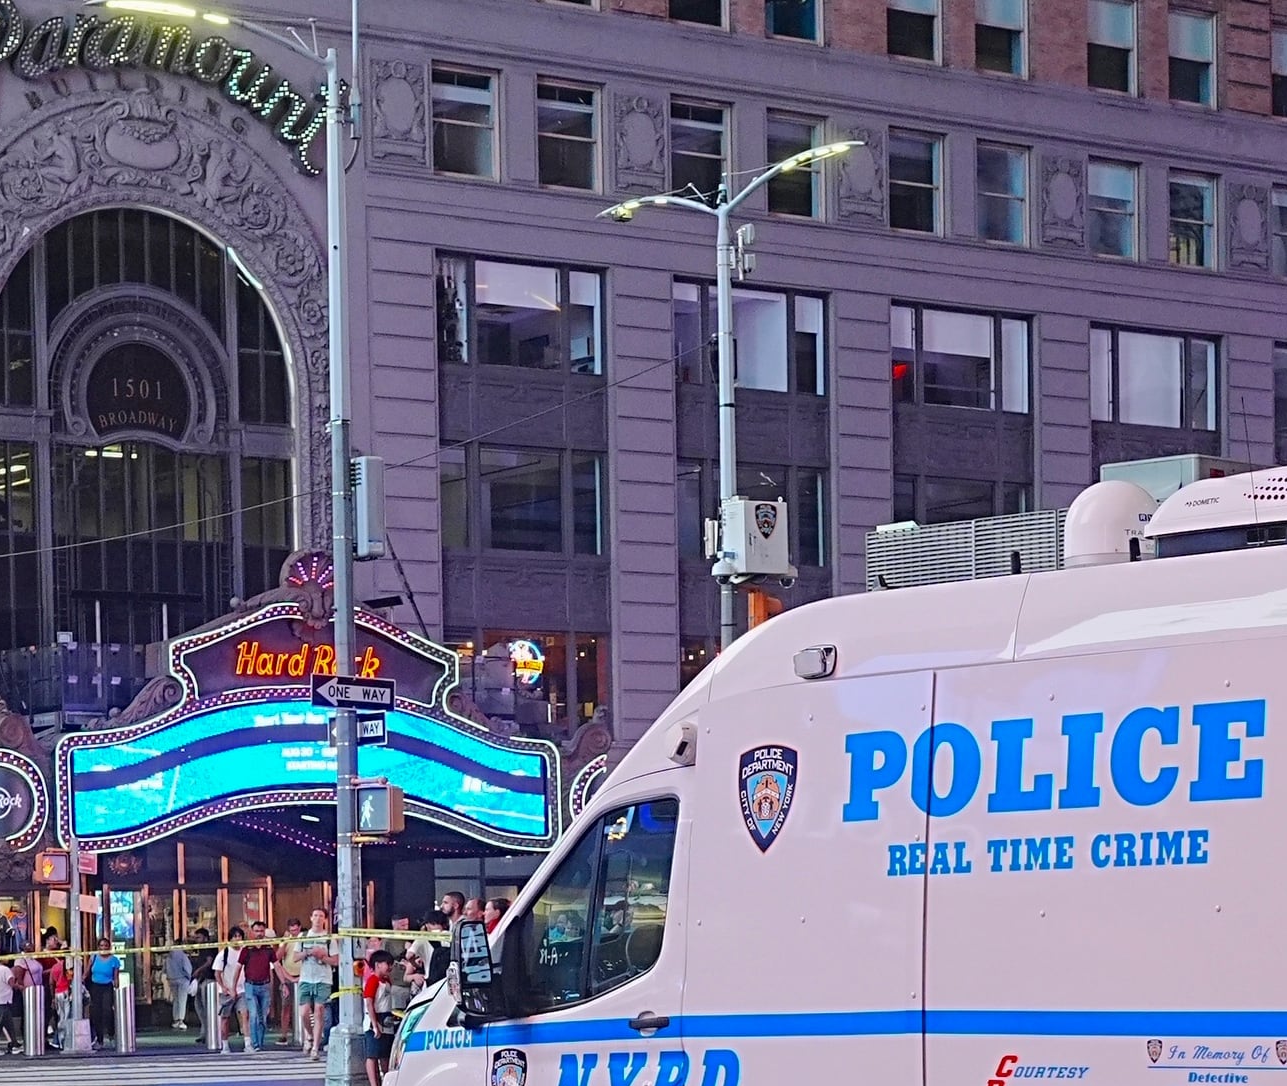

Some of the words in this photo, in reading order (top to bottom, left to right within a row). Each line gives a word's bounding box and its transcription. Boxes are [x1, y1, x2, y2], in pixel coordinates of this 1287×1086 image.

[112, 377, 164, 400] 1501
[98, 409, 178, 432] BROADWAY
[235, 641, 309, 677] Hard
[313, 644, 381, 679] Rk
[328, 685, 351, 699] ONE
[361, 688, 386, 701] WAY
[362, 721, 380, 735] WAY
[754, 748, 783, 761] POLICE
[841, 698, 1266, 823] POLICE
[741, 759, 794, 779] DEPARTMENT
[740, 790, 750, 815] CITY
[746, 817, 756, 832] OF
[772, 811, 785, 835] NEW
[783, 783, 794, 809] YORK
[886, 838, 972, 878] REAL
[987, 834, 1075, 873] TIME
[1090, 829, 1210, 869] CRIME
[426, 1029, 472, 1050] POLICE
[995, 1054, 1090, 1079] COURTESY
[1168, 1045, 1186, 1060] In
[1193, 1045, 1245, 1066] Memory
[1251, 1045, 1270, 1061] Of
[1188, 1072, 1249, 1084] Detective
